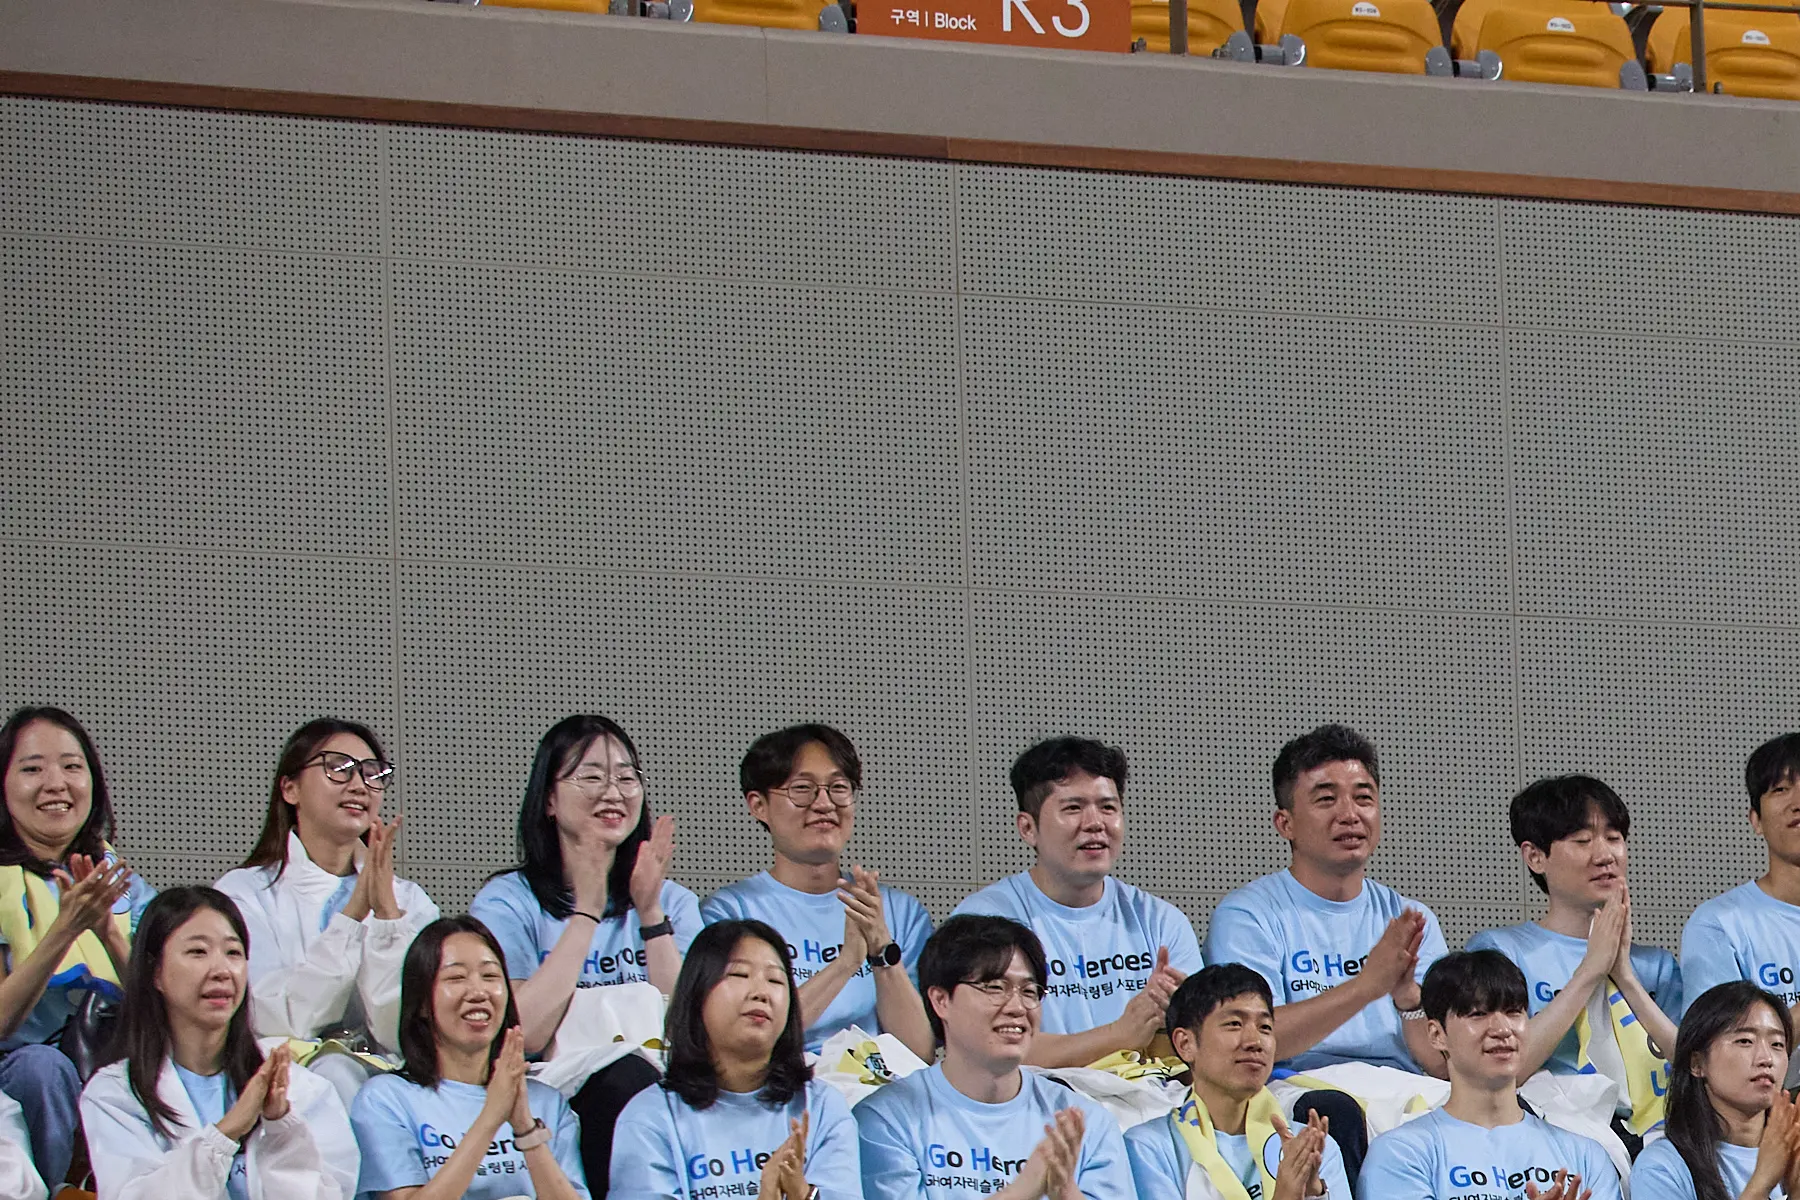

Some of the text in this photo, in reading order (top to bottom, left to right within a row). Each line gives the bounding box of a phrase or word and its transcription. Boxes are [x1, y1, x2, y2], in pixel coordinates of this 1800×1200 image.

[890, 9, 978, 32] 구역 Block
[1073, 951, 1153, 979] Heroes
[1291, 950, 1320, 975] Go
[1758, 963, 1794, 987] Go
[420, 1123, 457, 1150] Go
[689, 1153, 725, 1180] Go
[927, 1143, 963, 1168] Go
[1449, 1165, 1487, 1188] Go
